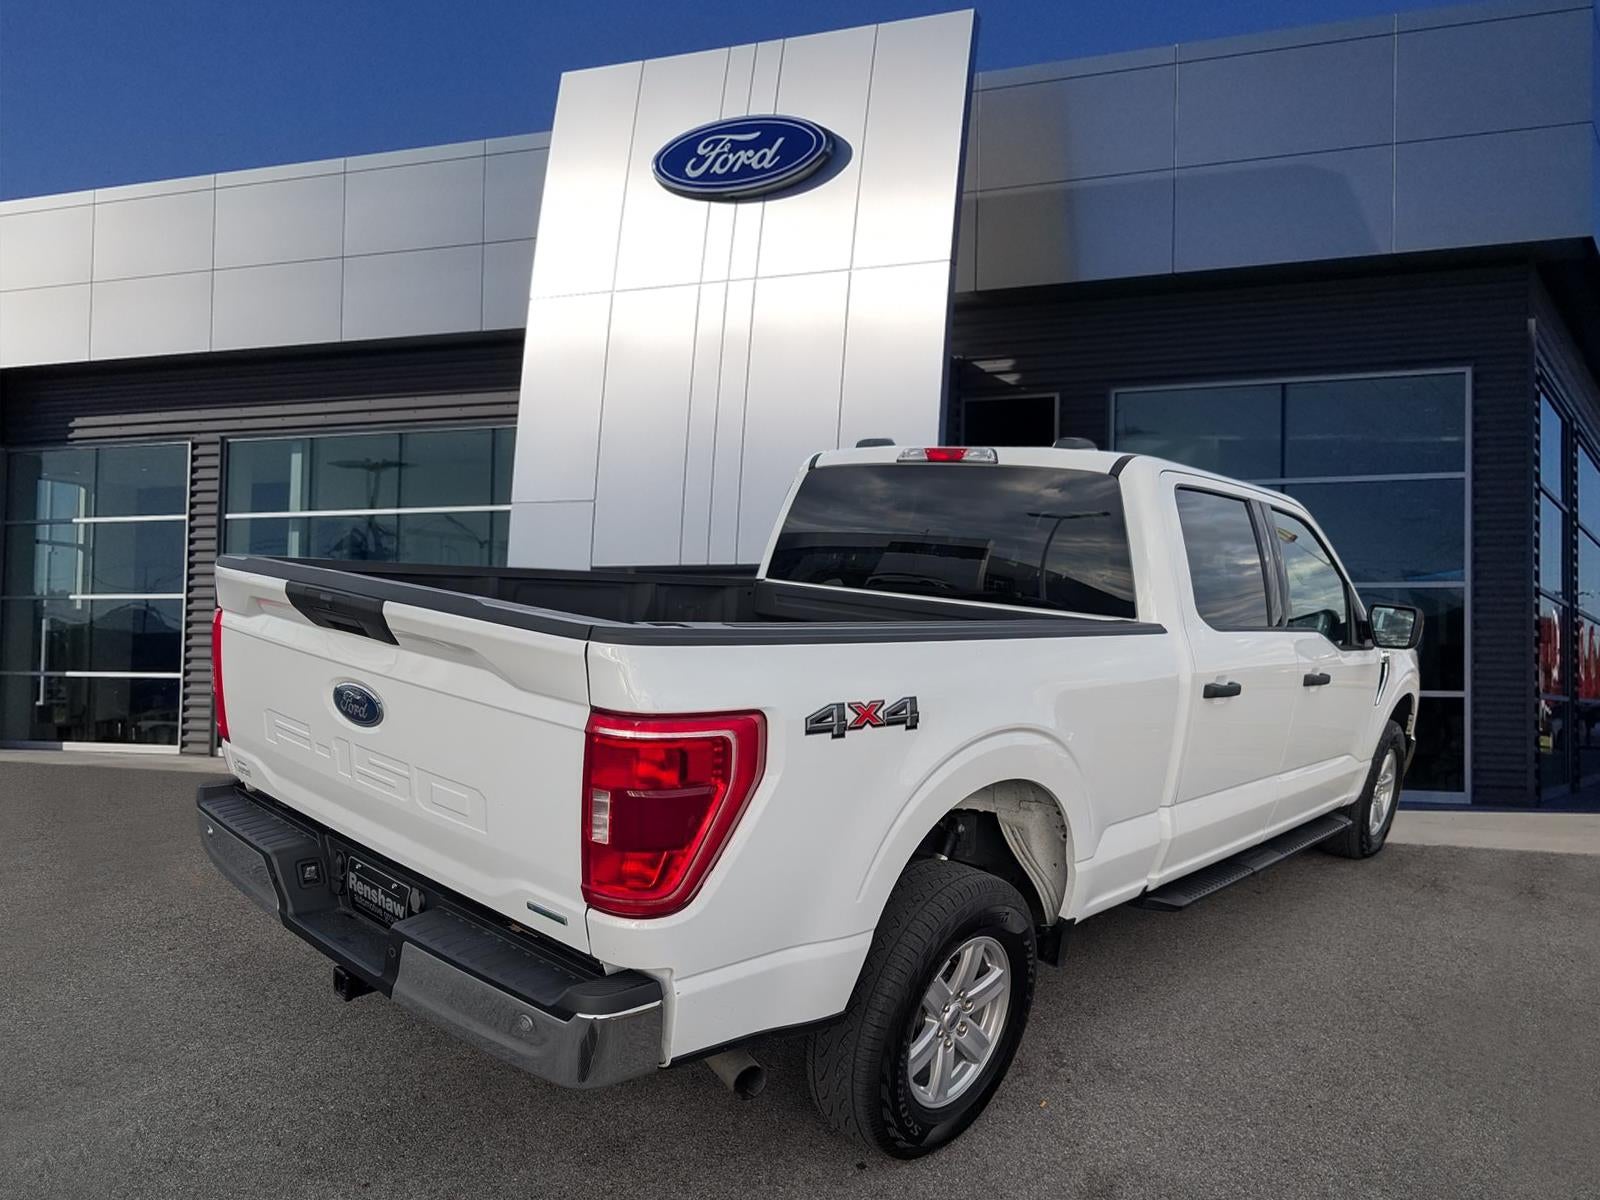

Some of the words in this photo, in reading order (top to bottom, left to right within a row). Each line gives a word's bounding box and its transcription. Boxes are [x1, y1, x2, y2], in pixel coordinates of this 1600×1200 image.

[685, 131, 785, 178] Ford
[340, 690, 369, 719] Ford
[264, 707, 488, 835] F-150
[349, 871, 405, 919] Renshaw
